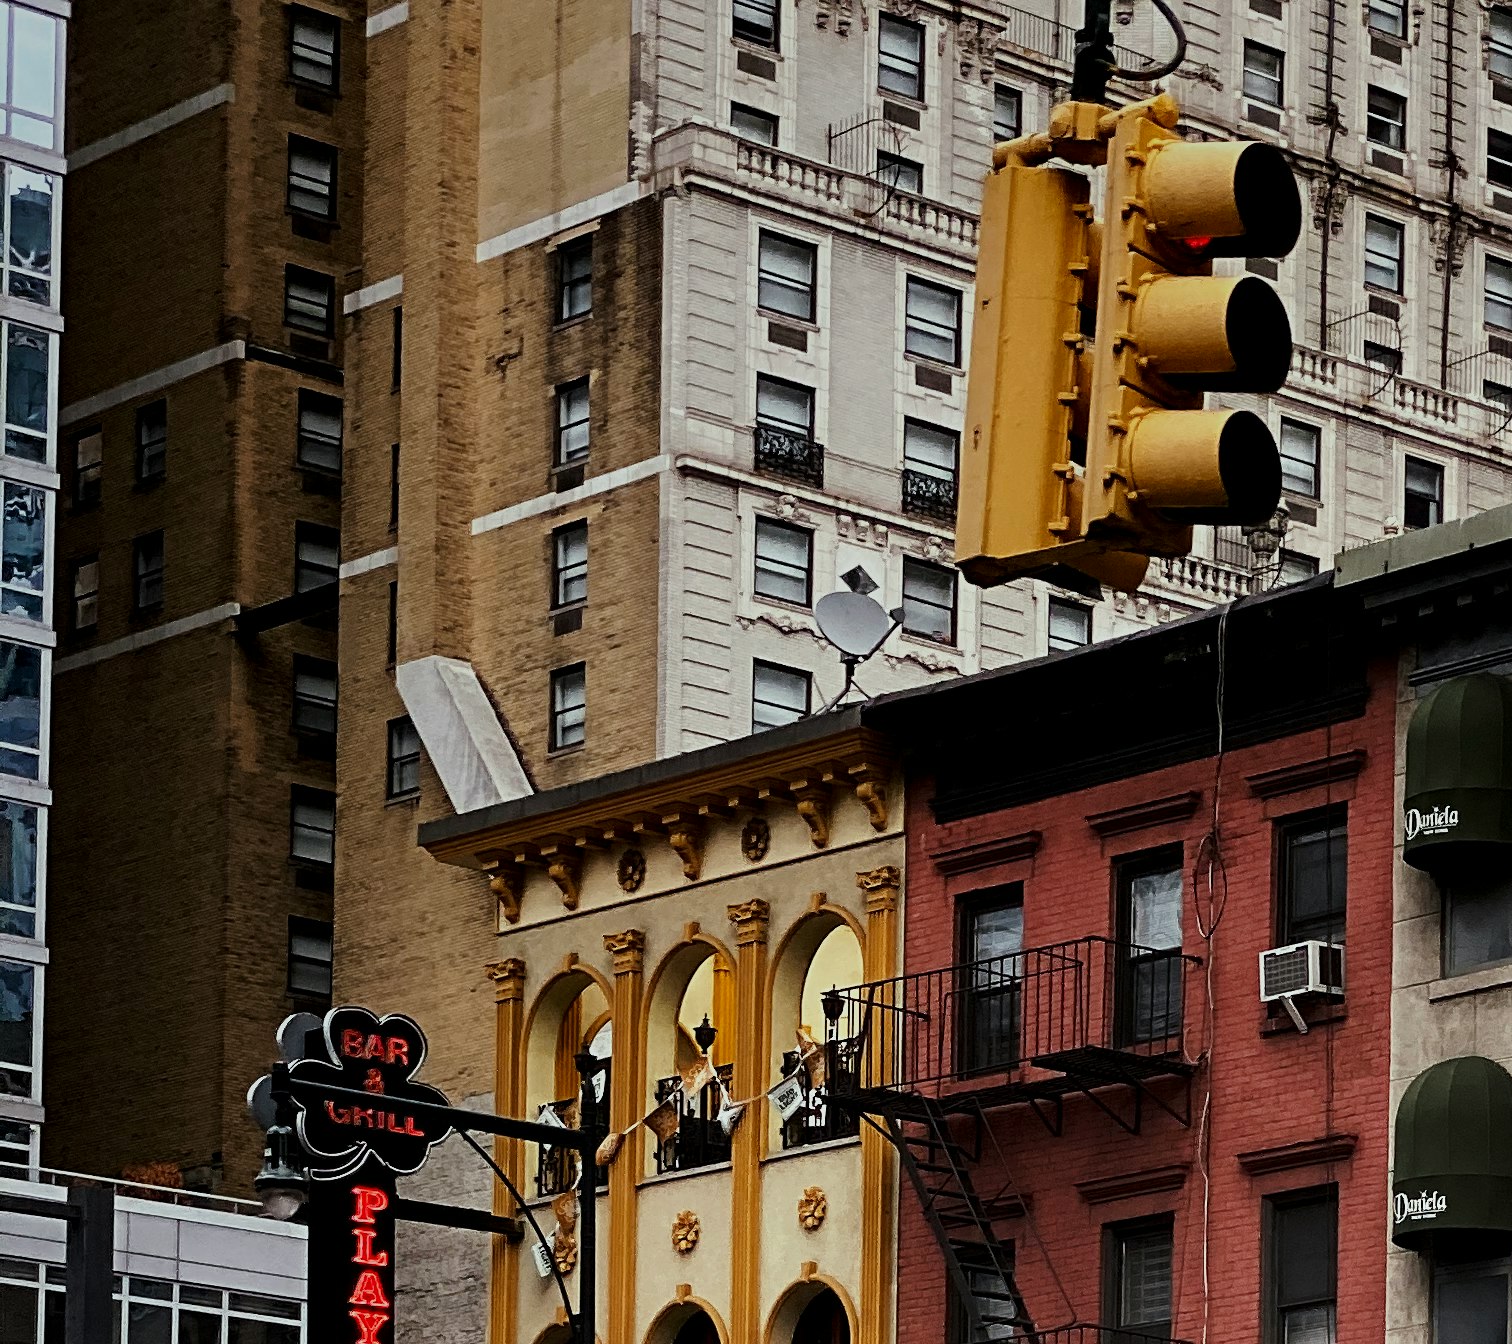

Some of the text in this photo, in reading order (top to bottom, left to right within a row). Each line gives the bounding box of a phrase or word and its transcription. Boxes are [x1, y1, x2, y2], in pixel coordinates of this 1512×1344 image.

[1405, 805, 1459, 840] Daniela
[341, 1029, 409, 1066] BAR
[363, 1068, 385, 1094] &
[1394, 1190, 1446, 1224] Daniela
